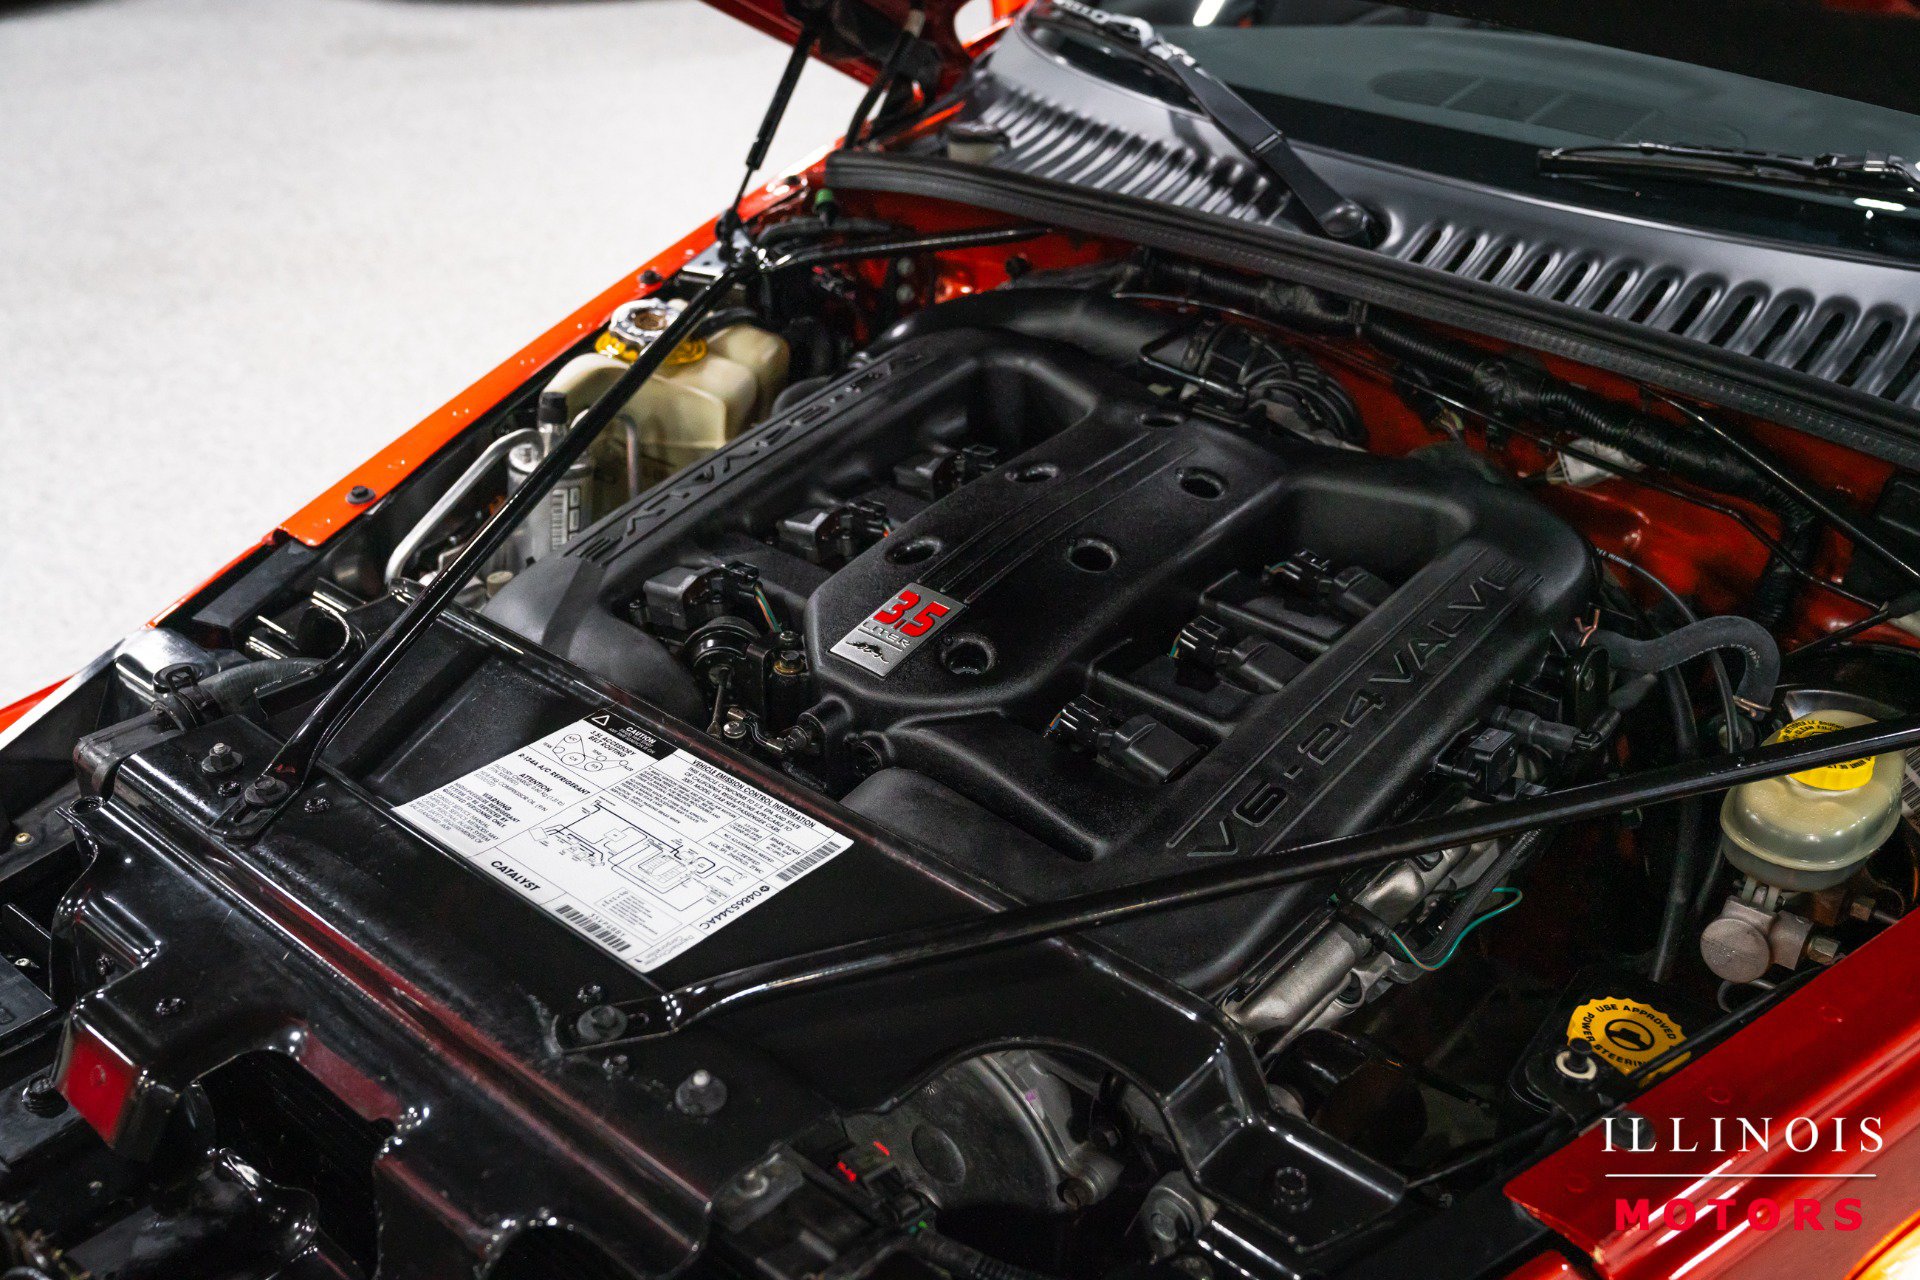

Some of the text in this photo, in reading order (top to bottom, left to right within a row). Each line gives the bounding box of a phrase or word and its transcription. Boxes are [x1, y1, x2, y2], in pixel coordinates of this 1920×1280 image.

[873, 590, 951, 637] 3.5
[862, 621, 912, 648] LITER
[587, 735, 603, 744] BELT
[598, 741, 628, 758] ROUTING
[588, 729, 604, 738] 3.5L
[600, 736, 637, 756] ACCESSORY
[623, 725, 658, 744] CAUTION
[517, 752, 591, 795] R-134A A/C REFRIGERANT
[518, 772, 553, 793] ATTENTION
[480, 791, 513, 811] WARNING
[689, 775, 723, 793] CALIFORNIA
[719, 791, 756, 812] REGULATIONS
[752, 809, 786, 828] APPLICABLE
[690, 759, 818, 828] VEHICLE EMISSION CONTROL INFORMATION
[696, 771, 719, 784] VEHICLE
[772, 812, 788, 822] AND
[784, 819, 802, 829] STATE
[464, 802, 494, 820] PERSONNEL
[476, 803, 502, 818] SERVICED
[486, 802, 521, 823] REFRIGERANT
[734, 806, 767, 825] PASSENGER
[491, 861, 541, 891] CATALYST
[699, 890, 762, 930] 04865344AC
[1581, 1012, 1595, 1042] POWER
[1596, 1004, 1677, 1040] USE APPROVED
